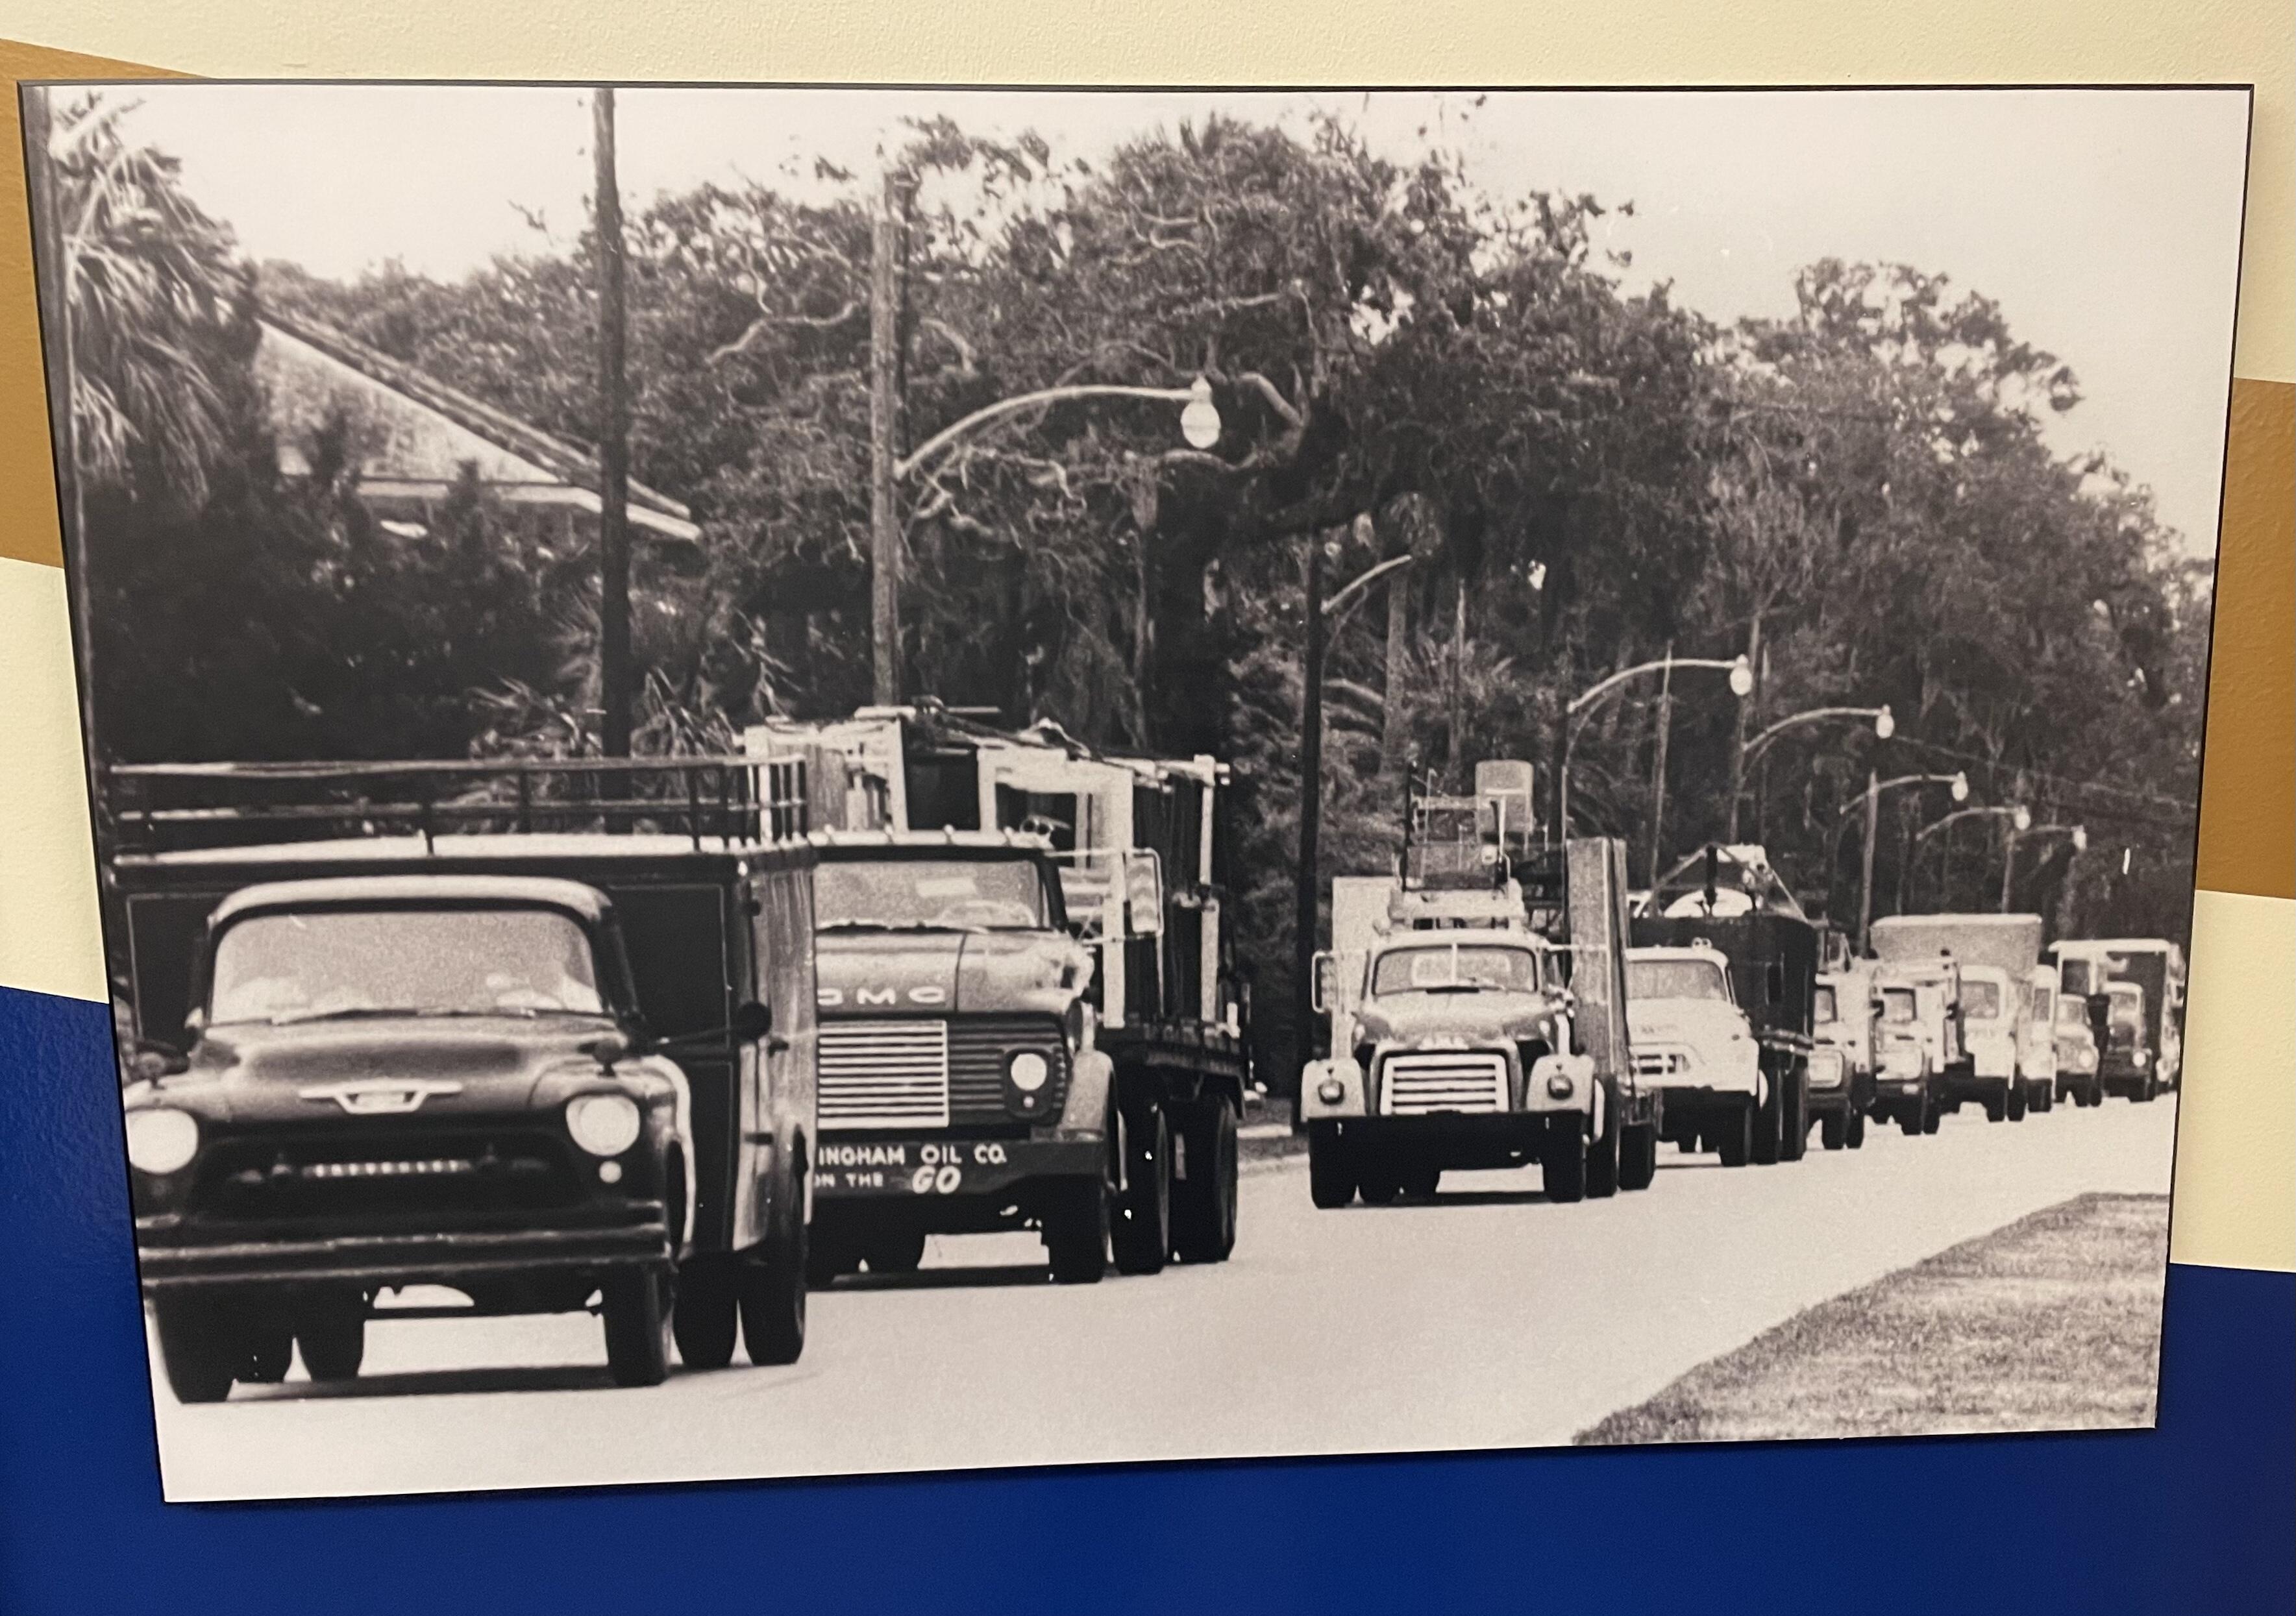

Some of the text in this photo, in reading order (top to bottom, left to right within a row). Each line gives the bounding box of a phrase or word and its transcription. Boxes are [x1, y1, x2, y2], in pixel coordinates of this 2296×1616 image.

[920, 1144, 962, 1164] OIL
[846, 1171, 883, 1188] THE
[911, 1165, 962, 1194] GO
